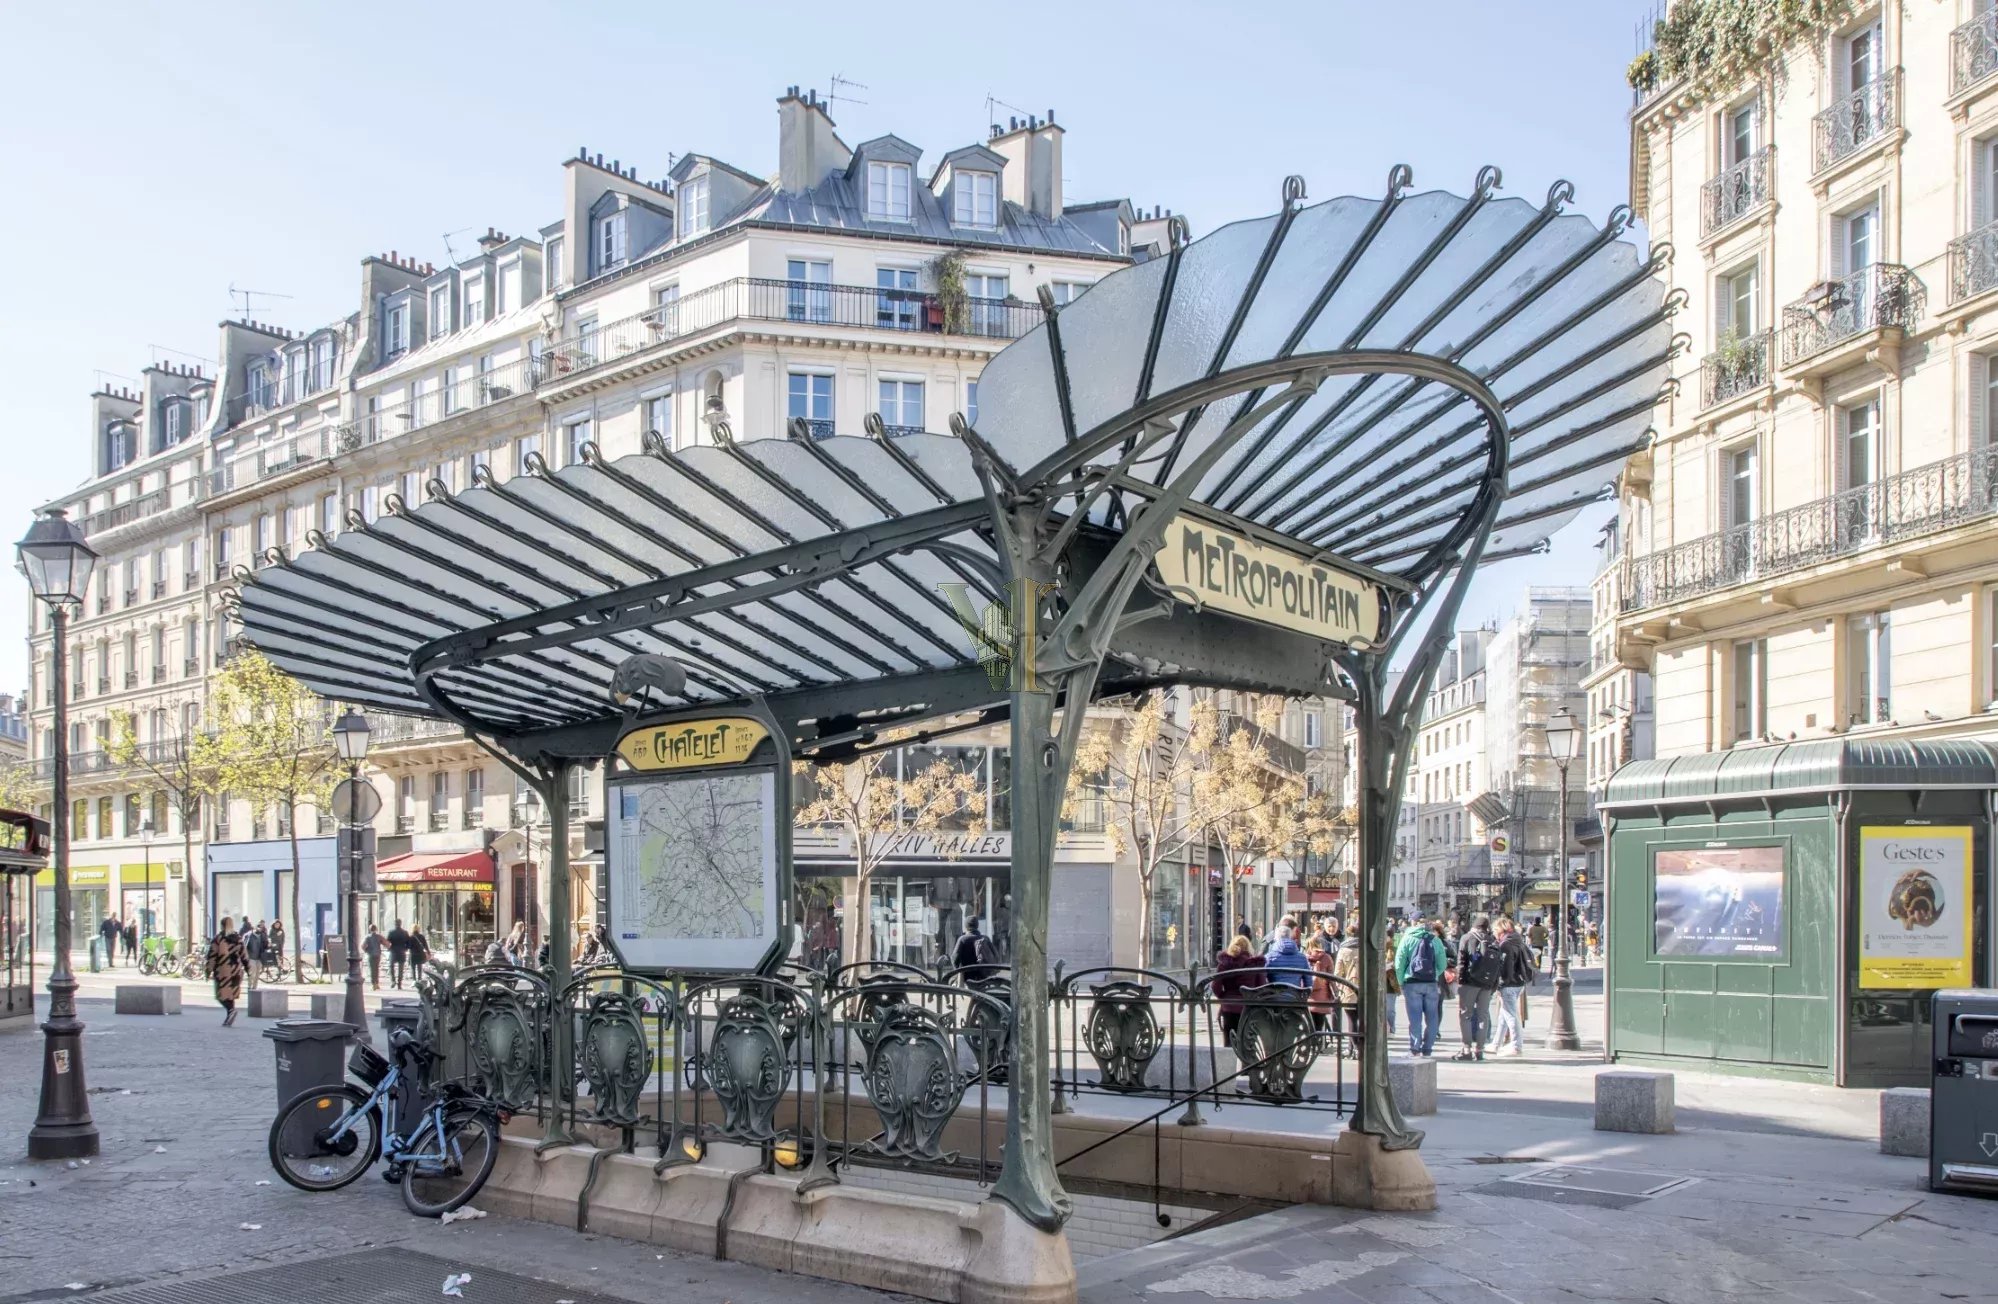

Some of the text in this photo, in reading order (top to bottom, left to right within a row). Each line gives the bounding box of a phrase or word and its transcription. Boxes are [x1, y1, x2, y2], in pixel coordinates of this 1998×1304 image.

[1182, 524, 1360, 632] METROPOLITAIN
[1882, 842, 1945, 861] Gestes
[427, 867, 478, 878] RESTAURANT
